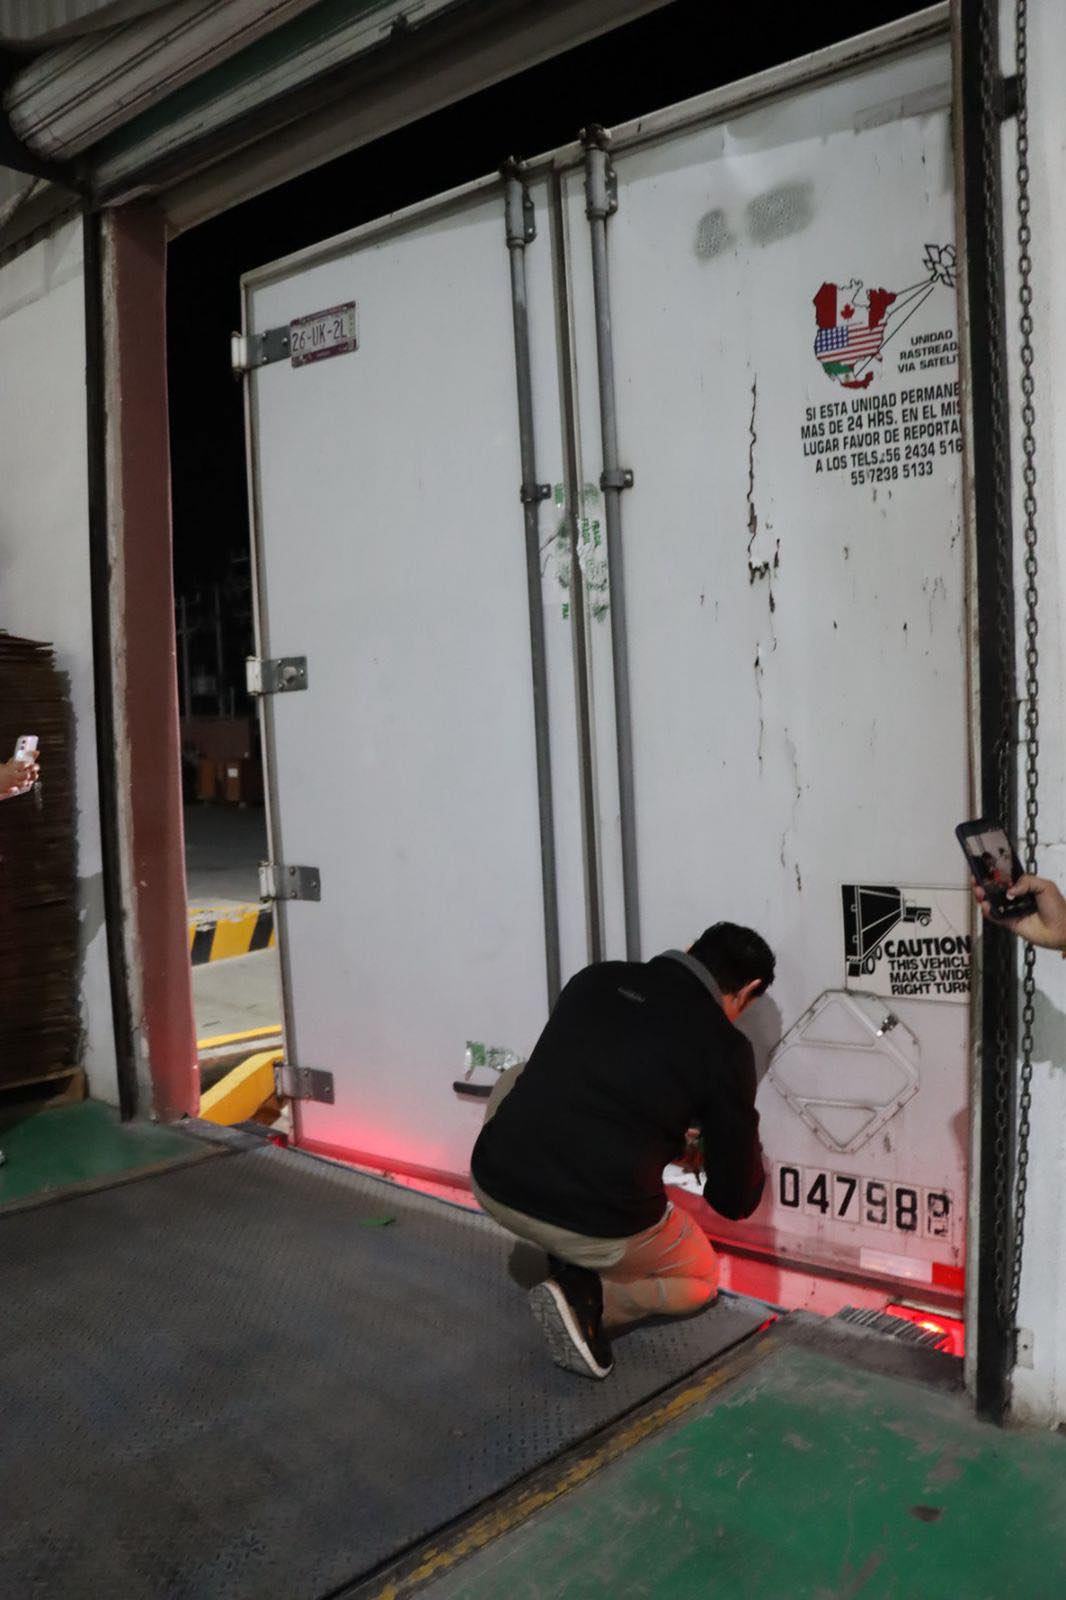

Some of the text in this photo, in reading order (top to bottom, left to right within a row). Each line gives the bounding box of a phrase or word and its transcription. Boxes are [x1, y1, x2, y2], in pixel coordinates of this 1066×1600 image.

[911, 329, 953, 346] UNIDAD
[900, 341, 959, 360] RASTREAD
[897, 353, 958, 373] VIA SATELI
[806, 406, 816, 421] SI
[820, 401, 848, 419] ESTA
[851, 392, 896, 413] UNIDAD
[801, 422, 825, 439] MAS
[829, 419, 843, 435] DE
[847, 414, 863, 432] 24
[867, 409, 898, 428] HRS.
[902, 406, 918, 423] EN
[923, 404, 937, 420] EL
[803, 418, 962, 456] LUGAR FAVOR DE REPORTA
[816, 459, 823, 474] A
[826, 455, 847, 471] LOS
[905, 441, 935, 460] 2434
[850, 461, 933, 486] 55 7238 5133
[884, 935, 971, 958] CAUTION
[888, 958, 919, 971] THIS
[890, 970, 936, 983] MAKES
[892, 983, 930, 995] RIGHT
